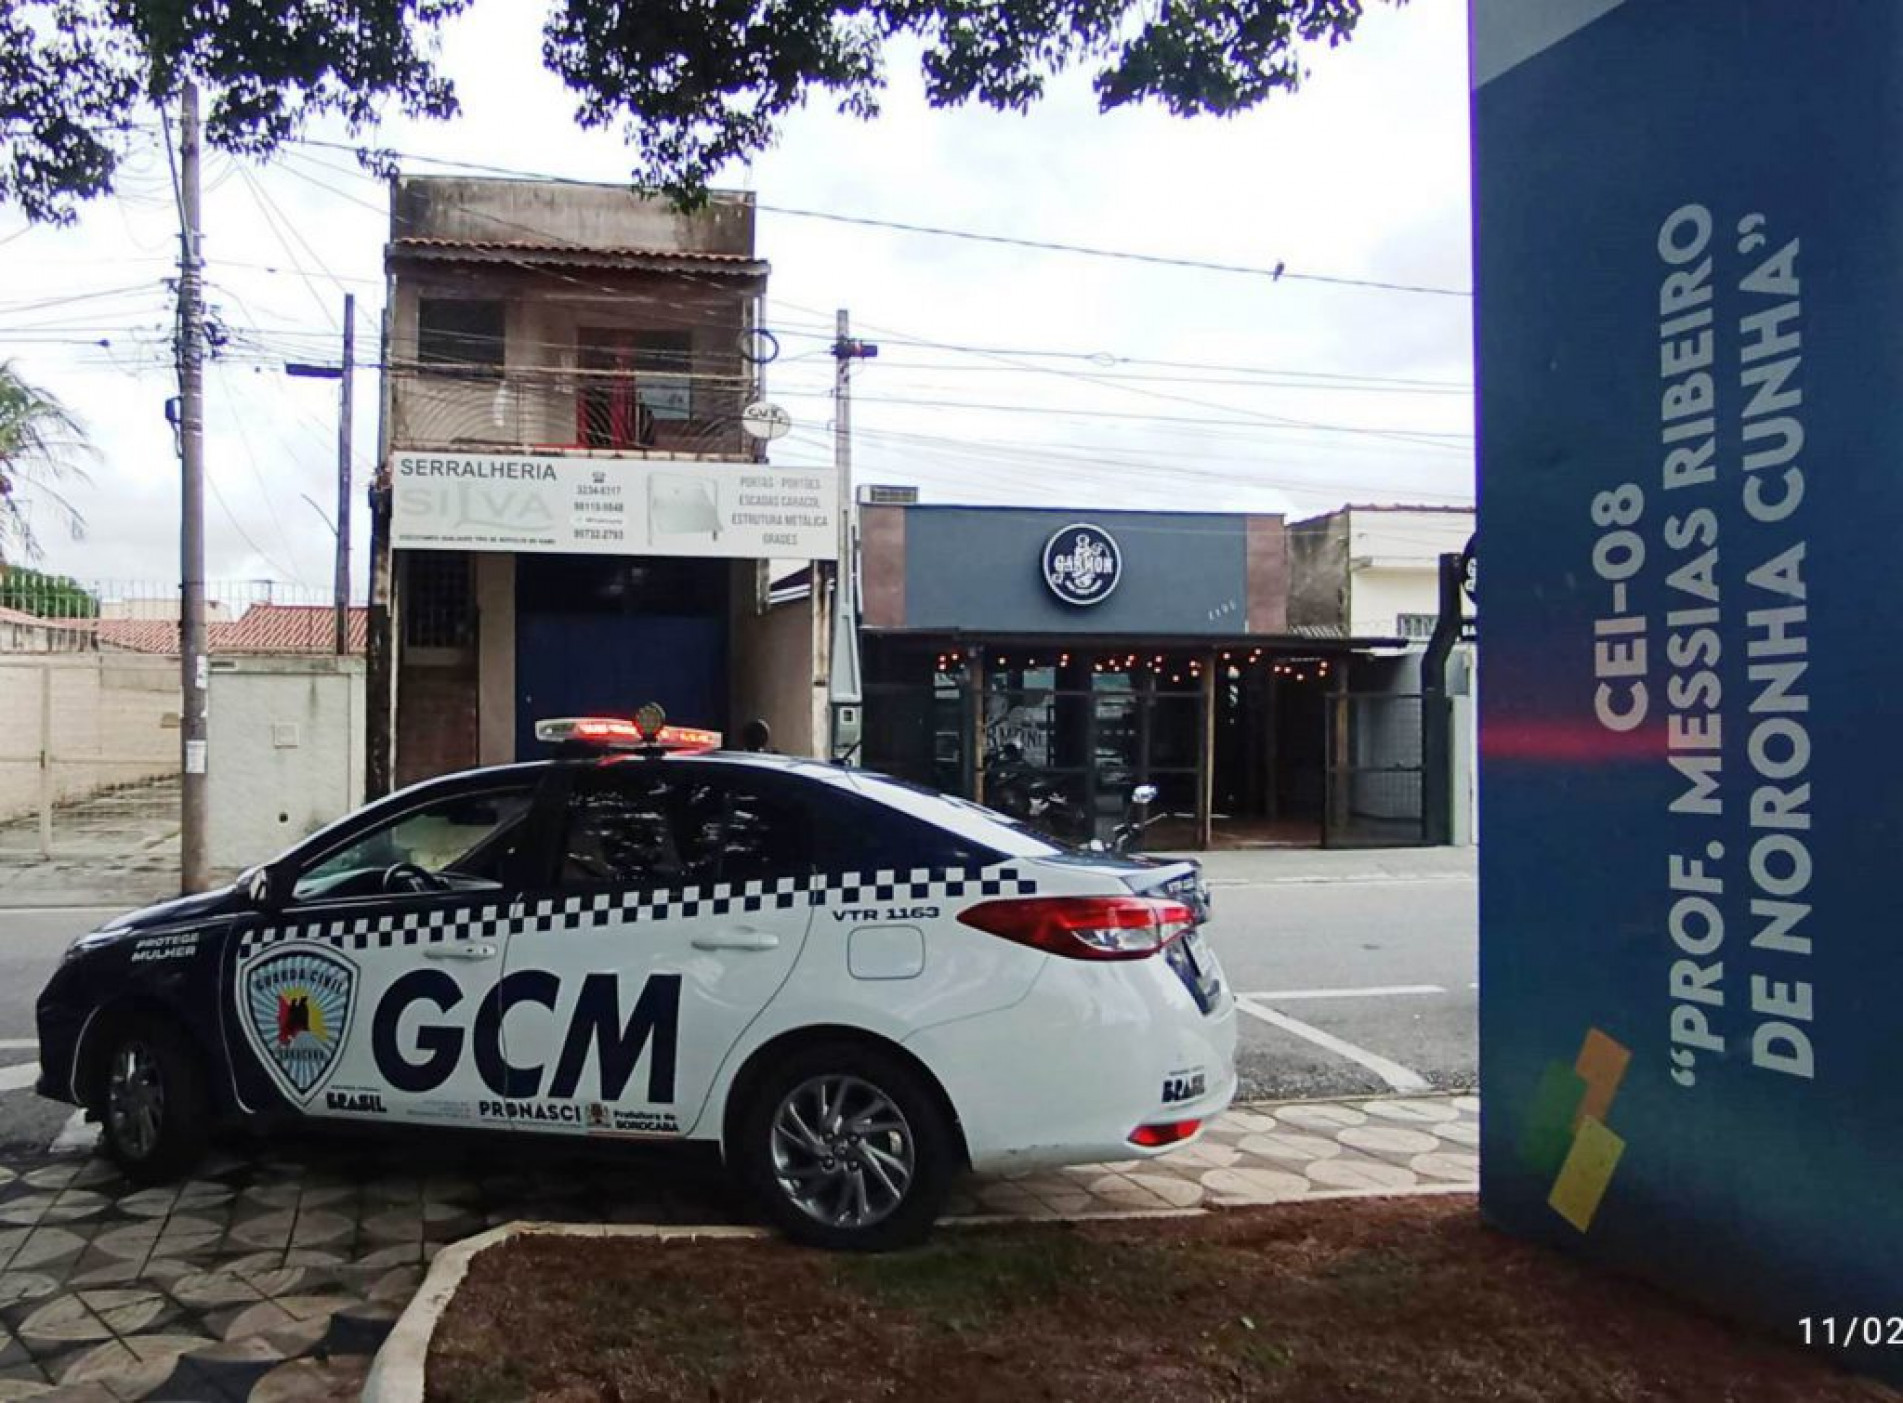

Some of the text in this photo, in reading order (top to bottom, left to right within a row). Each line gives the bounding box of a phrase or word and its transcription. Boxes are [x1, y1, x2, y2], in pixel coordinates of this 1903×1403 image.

[1656, 203, 1717, 490] RIBEIRO
[400, 458, 557, 481] SERRALHERIA
[1590, 482, 1649, 732] CEI-08
[1664, 507, 1723, 815] MESSIAS
[1745, 541, 1813, 955] NORONHA
[131, 945, 196, 962] MULHER
[136, 932, 200, 949] PROTEGE
[832, 908, 878, 922] VTR
[371, 968, 683, 1104] GCM
[1751, 974, 1815, 1079] DE
